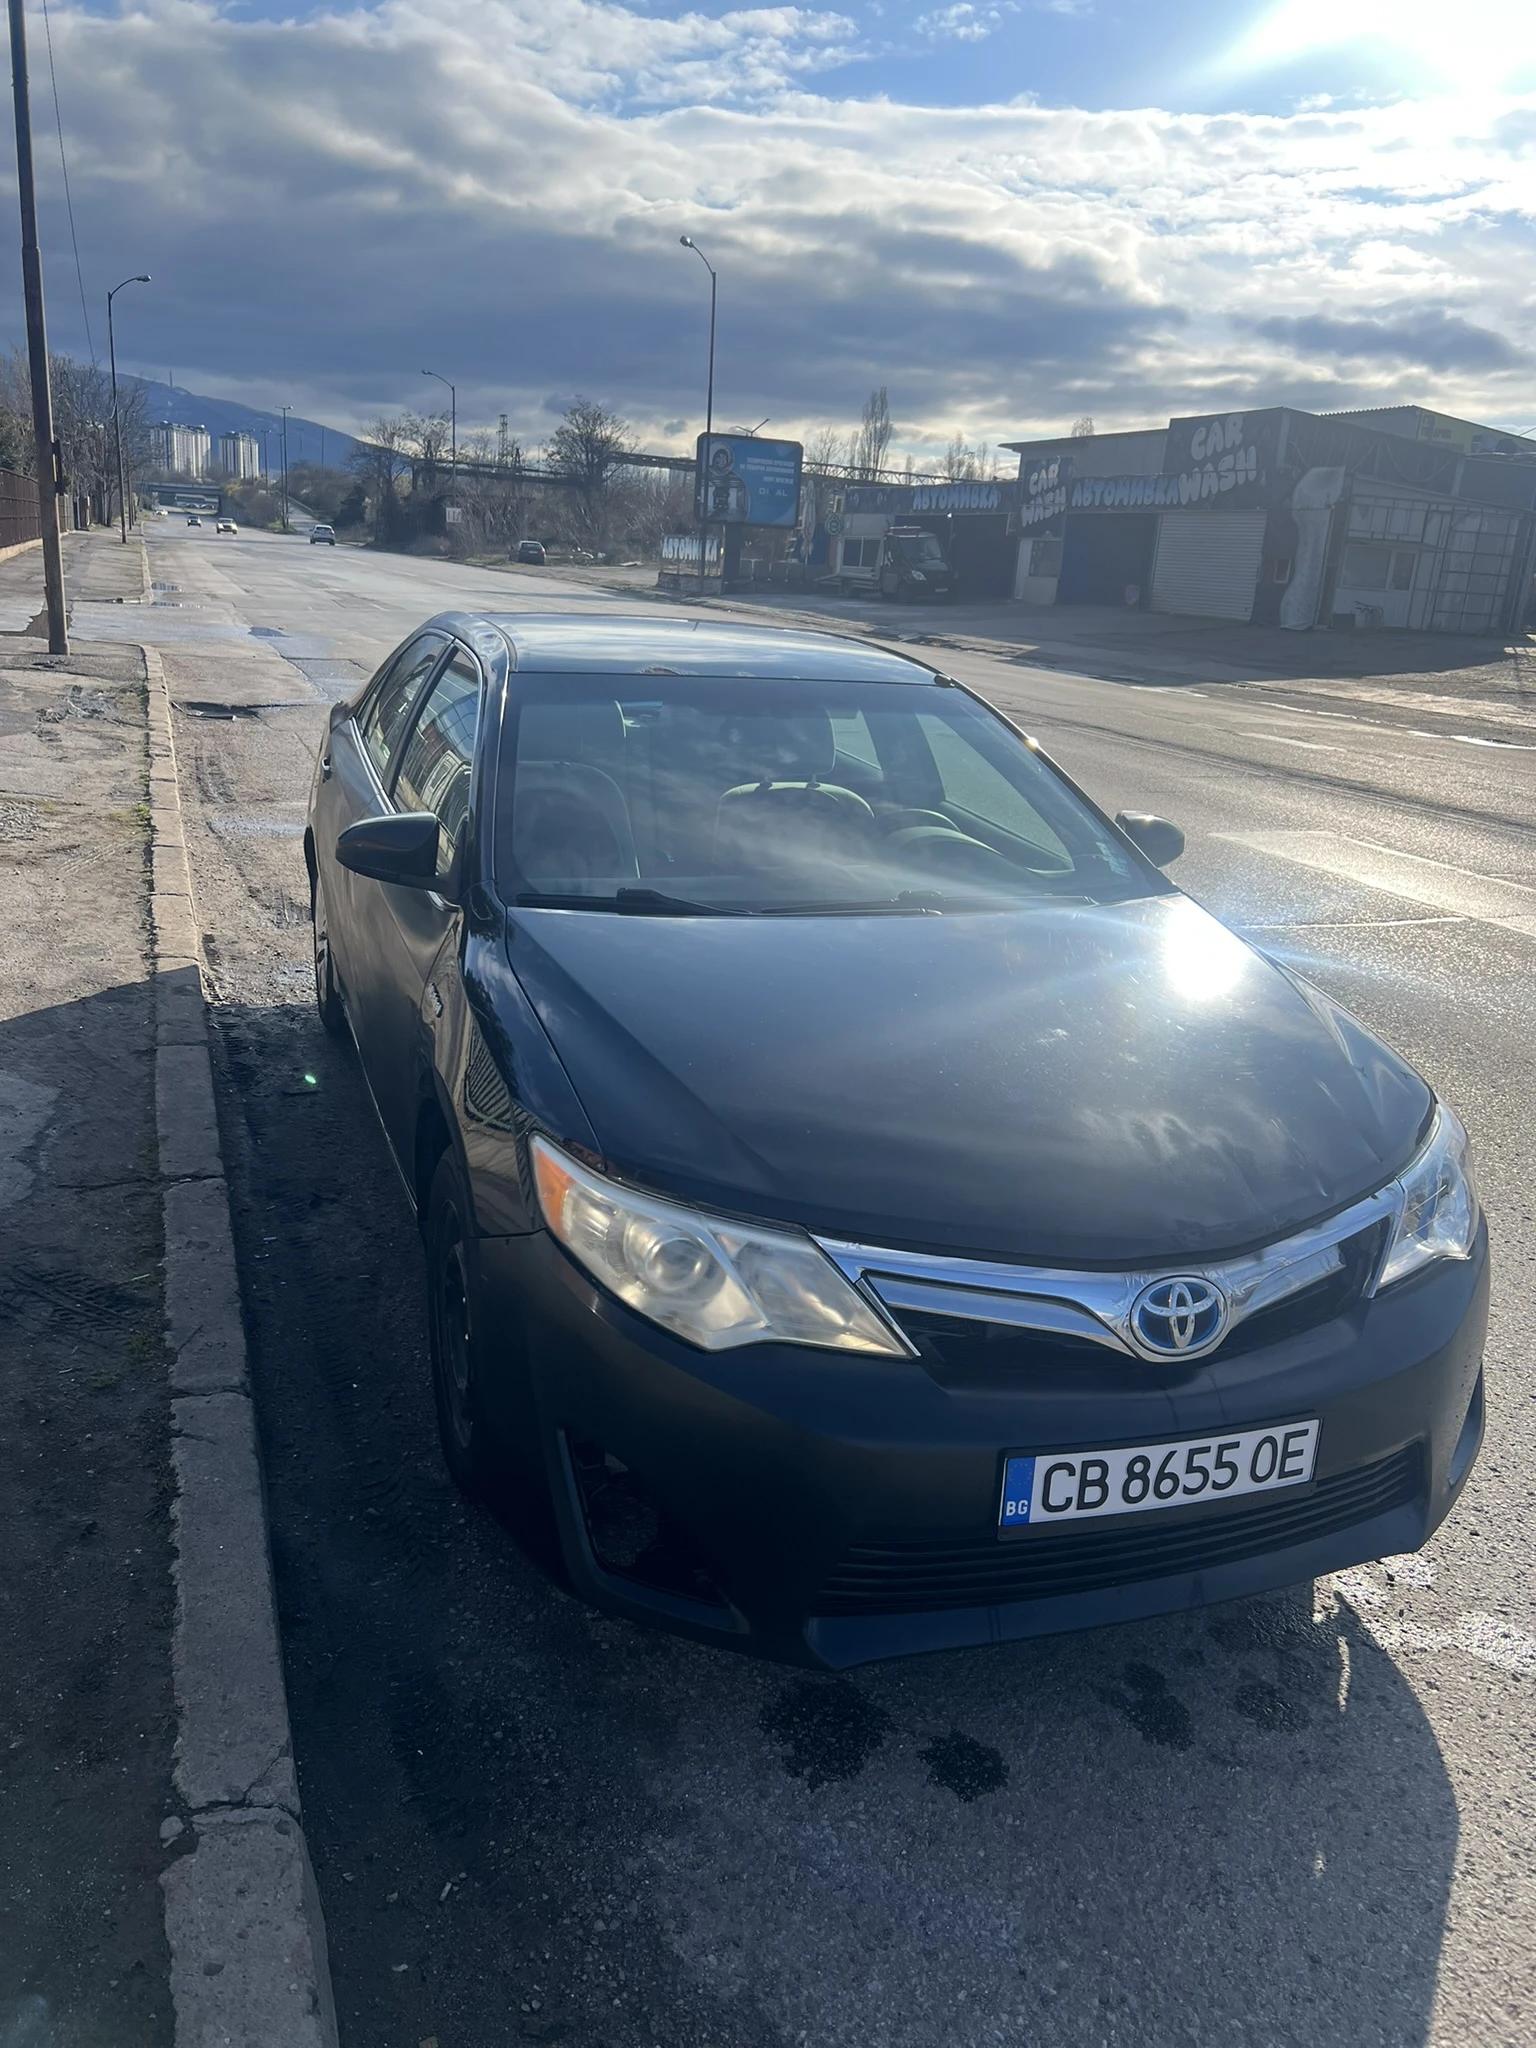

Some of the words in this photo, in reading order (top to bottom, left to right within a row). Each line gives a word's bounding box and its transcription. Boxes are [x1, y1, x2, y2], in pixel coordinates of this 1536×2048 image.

[1191, 415, 1244, 461] CAR
[1028, 463, 1061, 496] CAR
[1071, 477, 1179, 507] АВТОМИВКА
[1177, 445, 1257, 506] WASH
[912, 484, 1001, 511] АВТОМИВКА
[1021, 485, 1067, 528] WASH
[662, 537, 718, 562] АВТОМИКА
[1041, 1459, 1109, 1513] CB
[1121, 1441, 1240, 1504] 8655
[1005, 1500, 1028, 1517] BG
